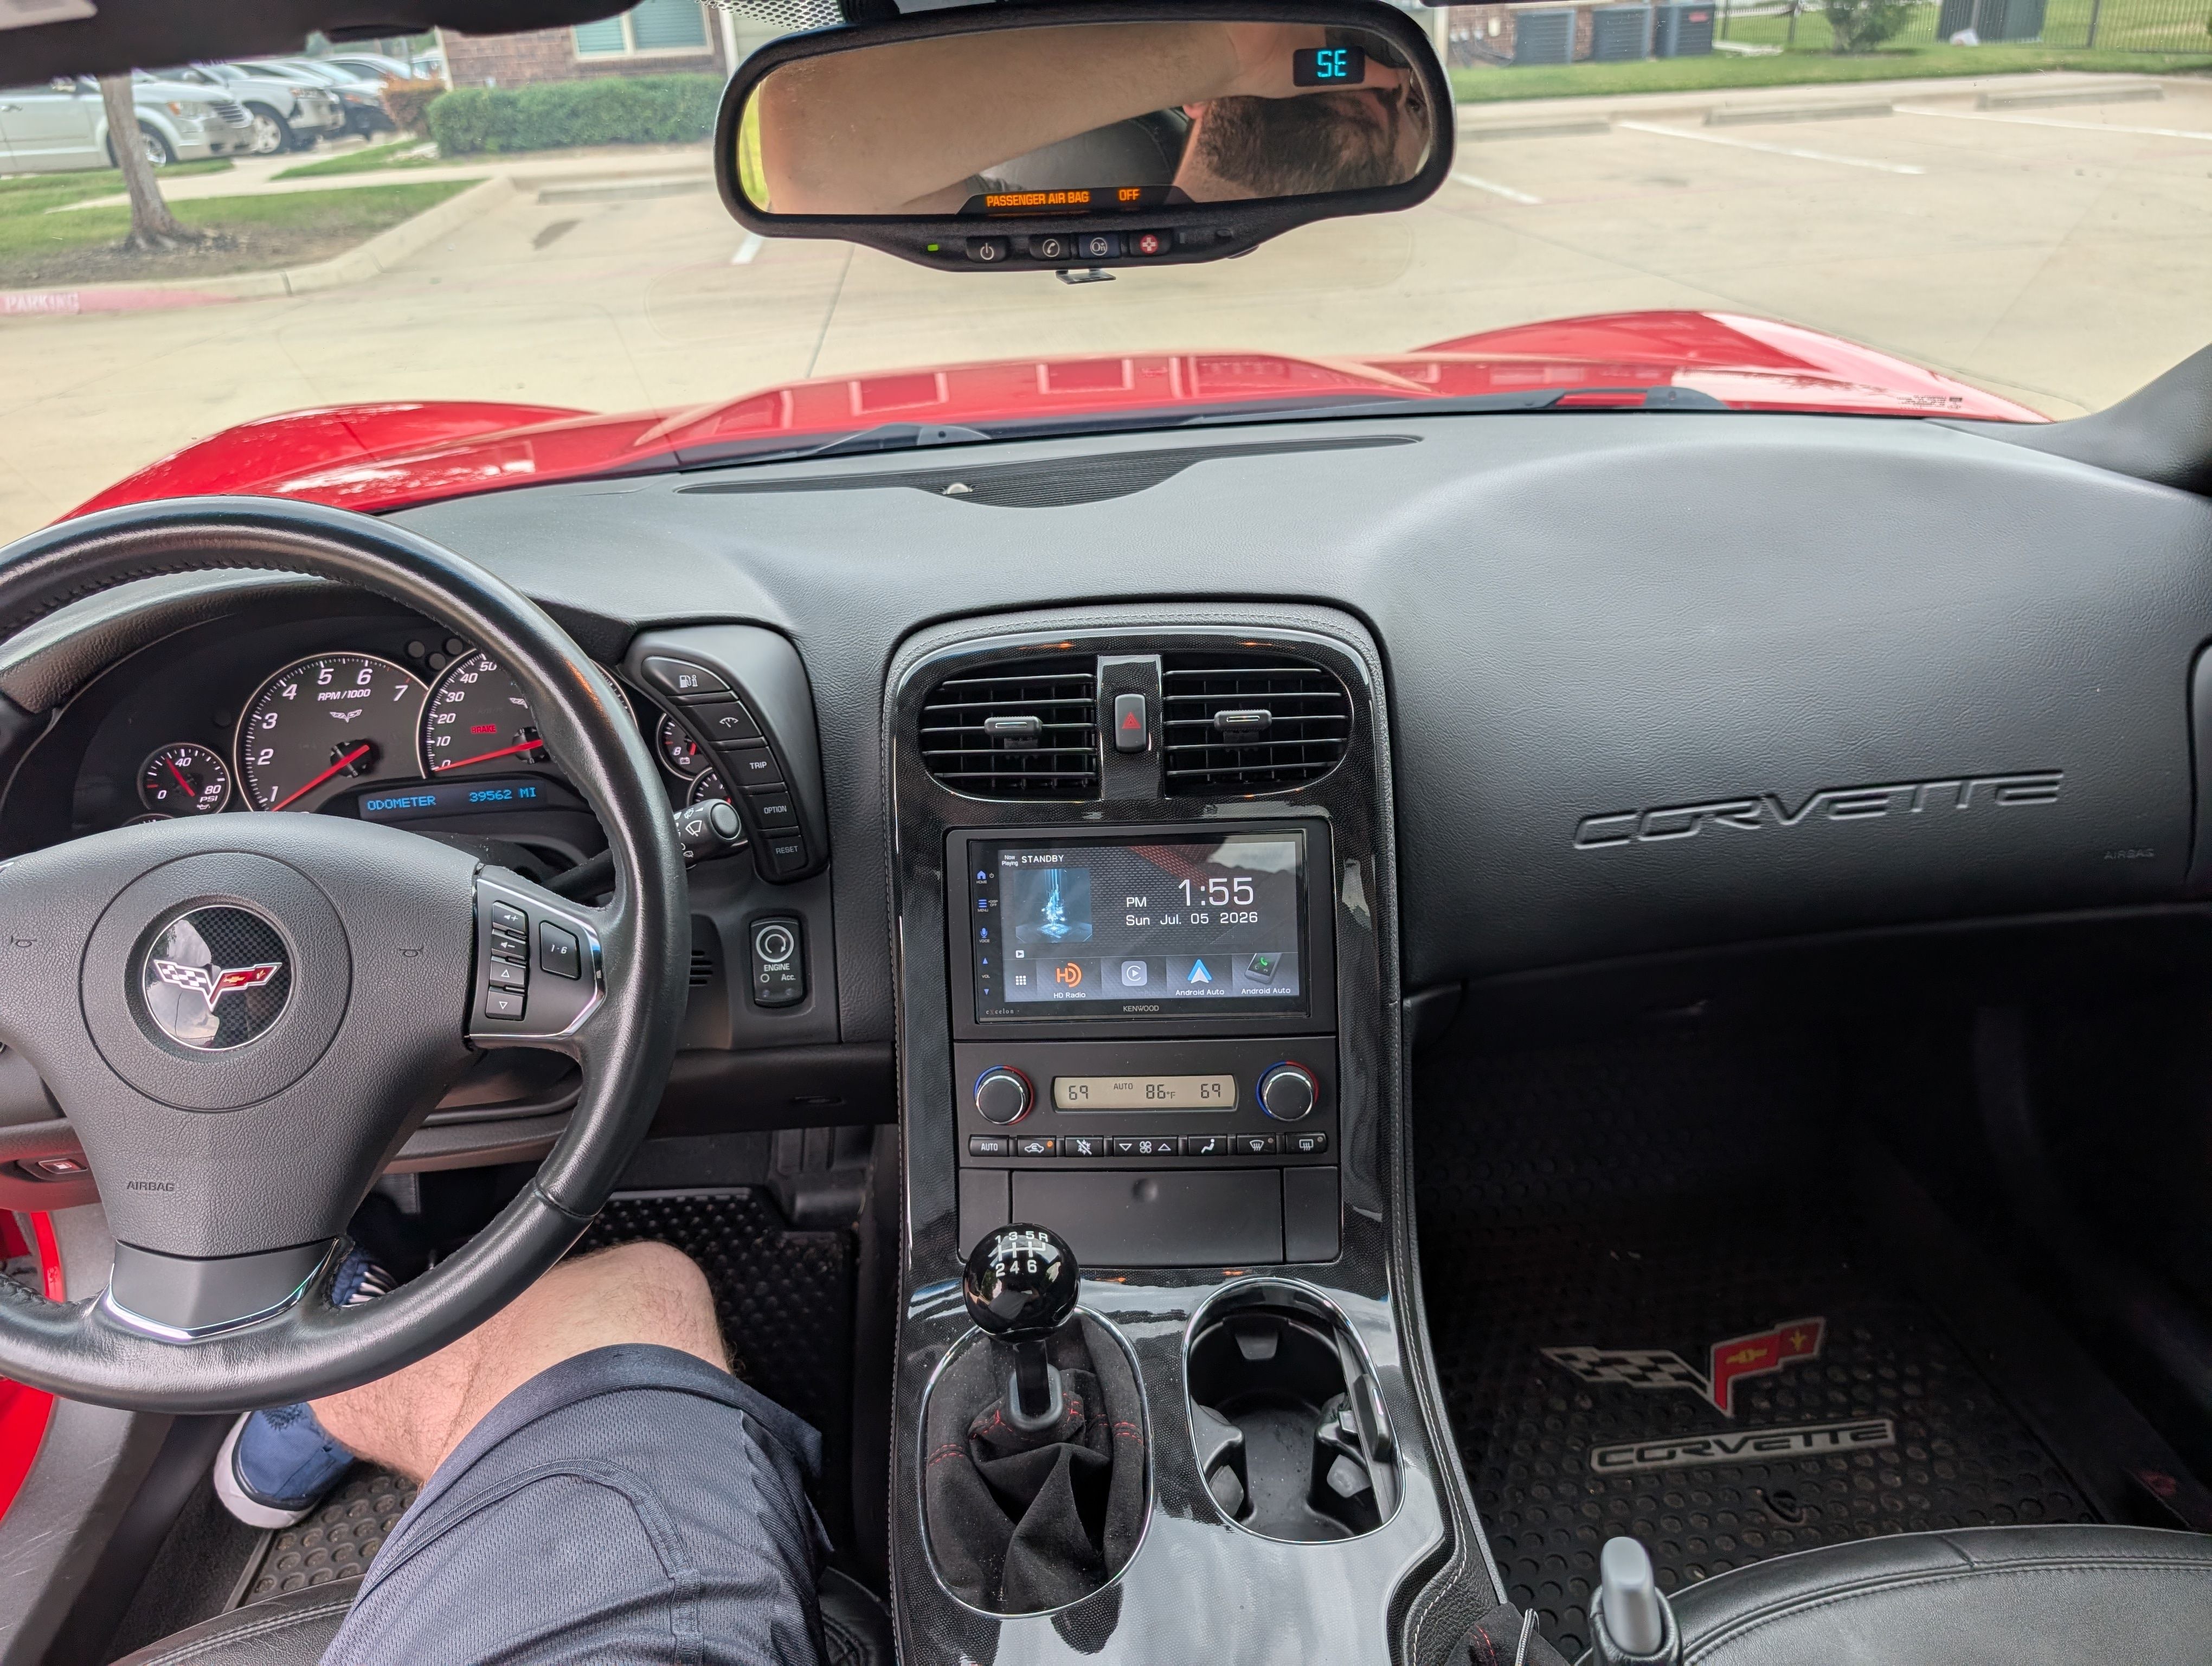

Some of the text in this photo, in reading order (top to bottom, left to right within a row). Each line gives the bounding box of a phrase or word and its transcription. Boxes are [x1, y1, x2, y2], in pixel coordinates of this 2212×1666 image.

[1317, 49, 1347, 78] SE
[987, 189, 1140, 207] PASSENGER AIR BAG OFF
[479, 661, 497, 671] 50
[317, 668, 335, 685] 5
[357, 668, 373, 685] 6
[460, 672, 478, 683] 40
[282, 684, 298, 700] 4
[393, 685, 408, 701] 7
[446, 691, 465, 702] 30
[262, 713, 278, 729] 3
[437, 713, 456, 724] 20
[471, 725, 497, 734] BRAKE
[436, 735, 451, 746] 10
[175, 757, 191, 767] 40
[257, 748, 274, 765] 2
[749, 761, 767, 770] TRIP
[157, 790, 167, 799] 0
[204, 785, 221, 794] 80
[270, 786, 278, 802] 1
[367, 787, 536, 811] ODOMETER 39562 MI
[763, 805, 787, 813] OPTION
[1572, 769, 2064, 849] CORVETTE
[776, 845, 798, 854] RESET
[1021, 855, 1064, 863] STANDBY
[1178, 877, 1253, 906] 1:55
[1126, 896, 1147, 907] PM
[1126, 912, 1258, 926] Sun Jul. 05 2026
[764, 963, 790, 971] ENGINE
[1068, 1085, 1089, 1100] 69
[1200, 1083, 1221, 1098] 69
[981, 1142, 998, 1151] AUTO
[126, 1181, 175, 1191] AIRBAG
[995, 1231, 1048, 1243] 1 3 5 R
[995, 1259, 1037, 1277] 2 4 6
[1597, 1422, 1888, 1468] CORVETTE
